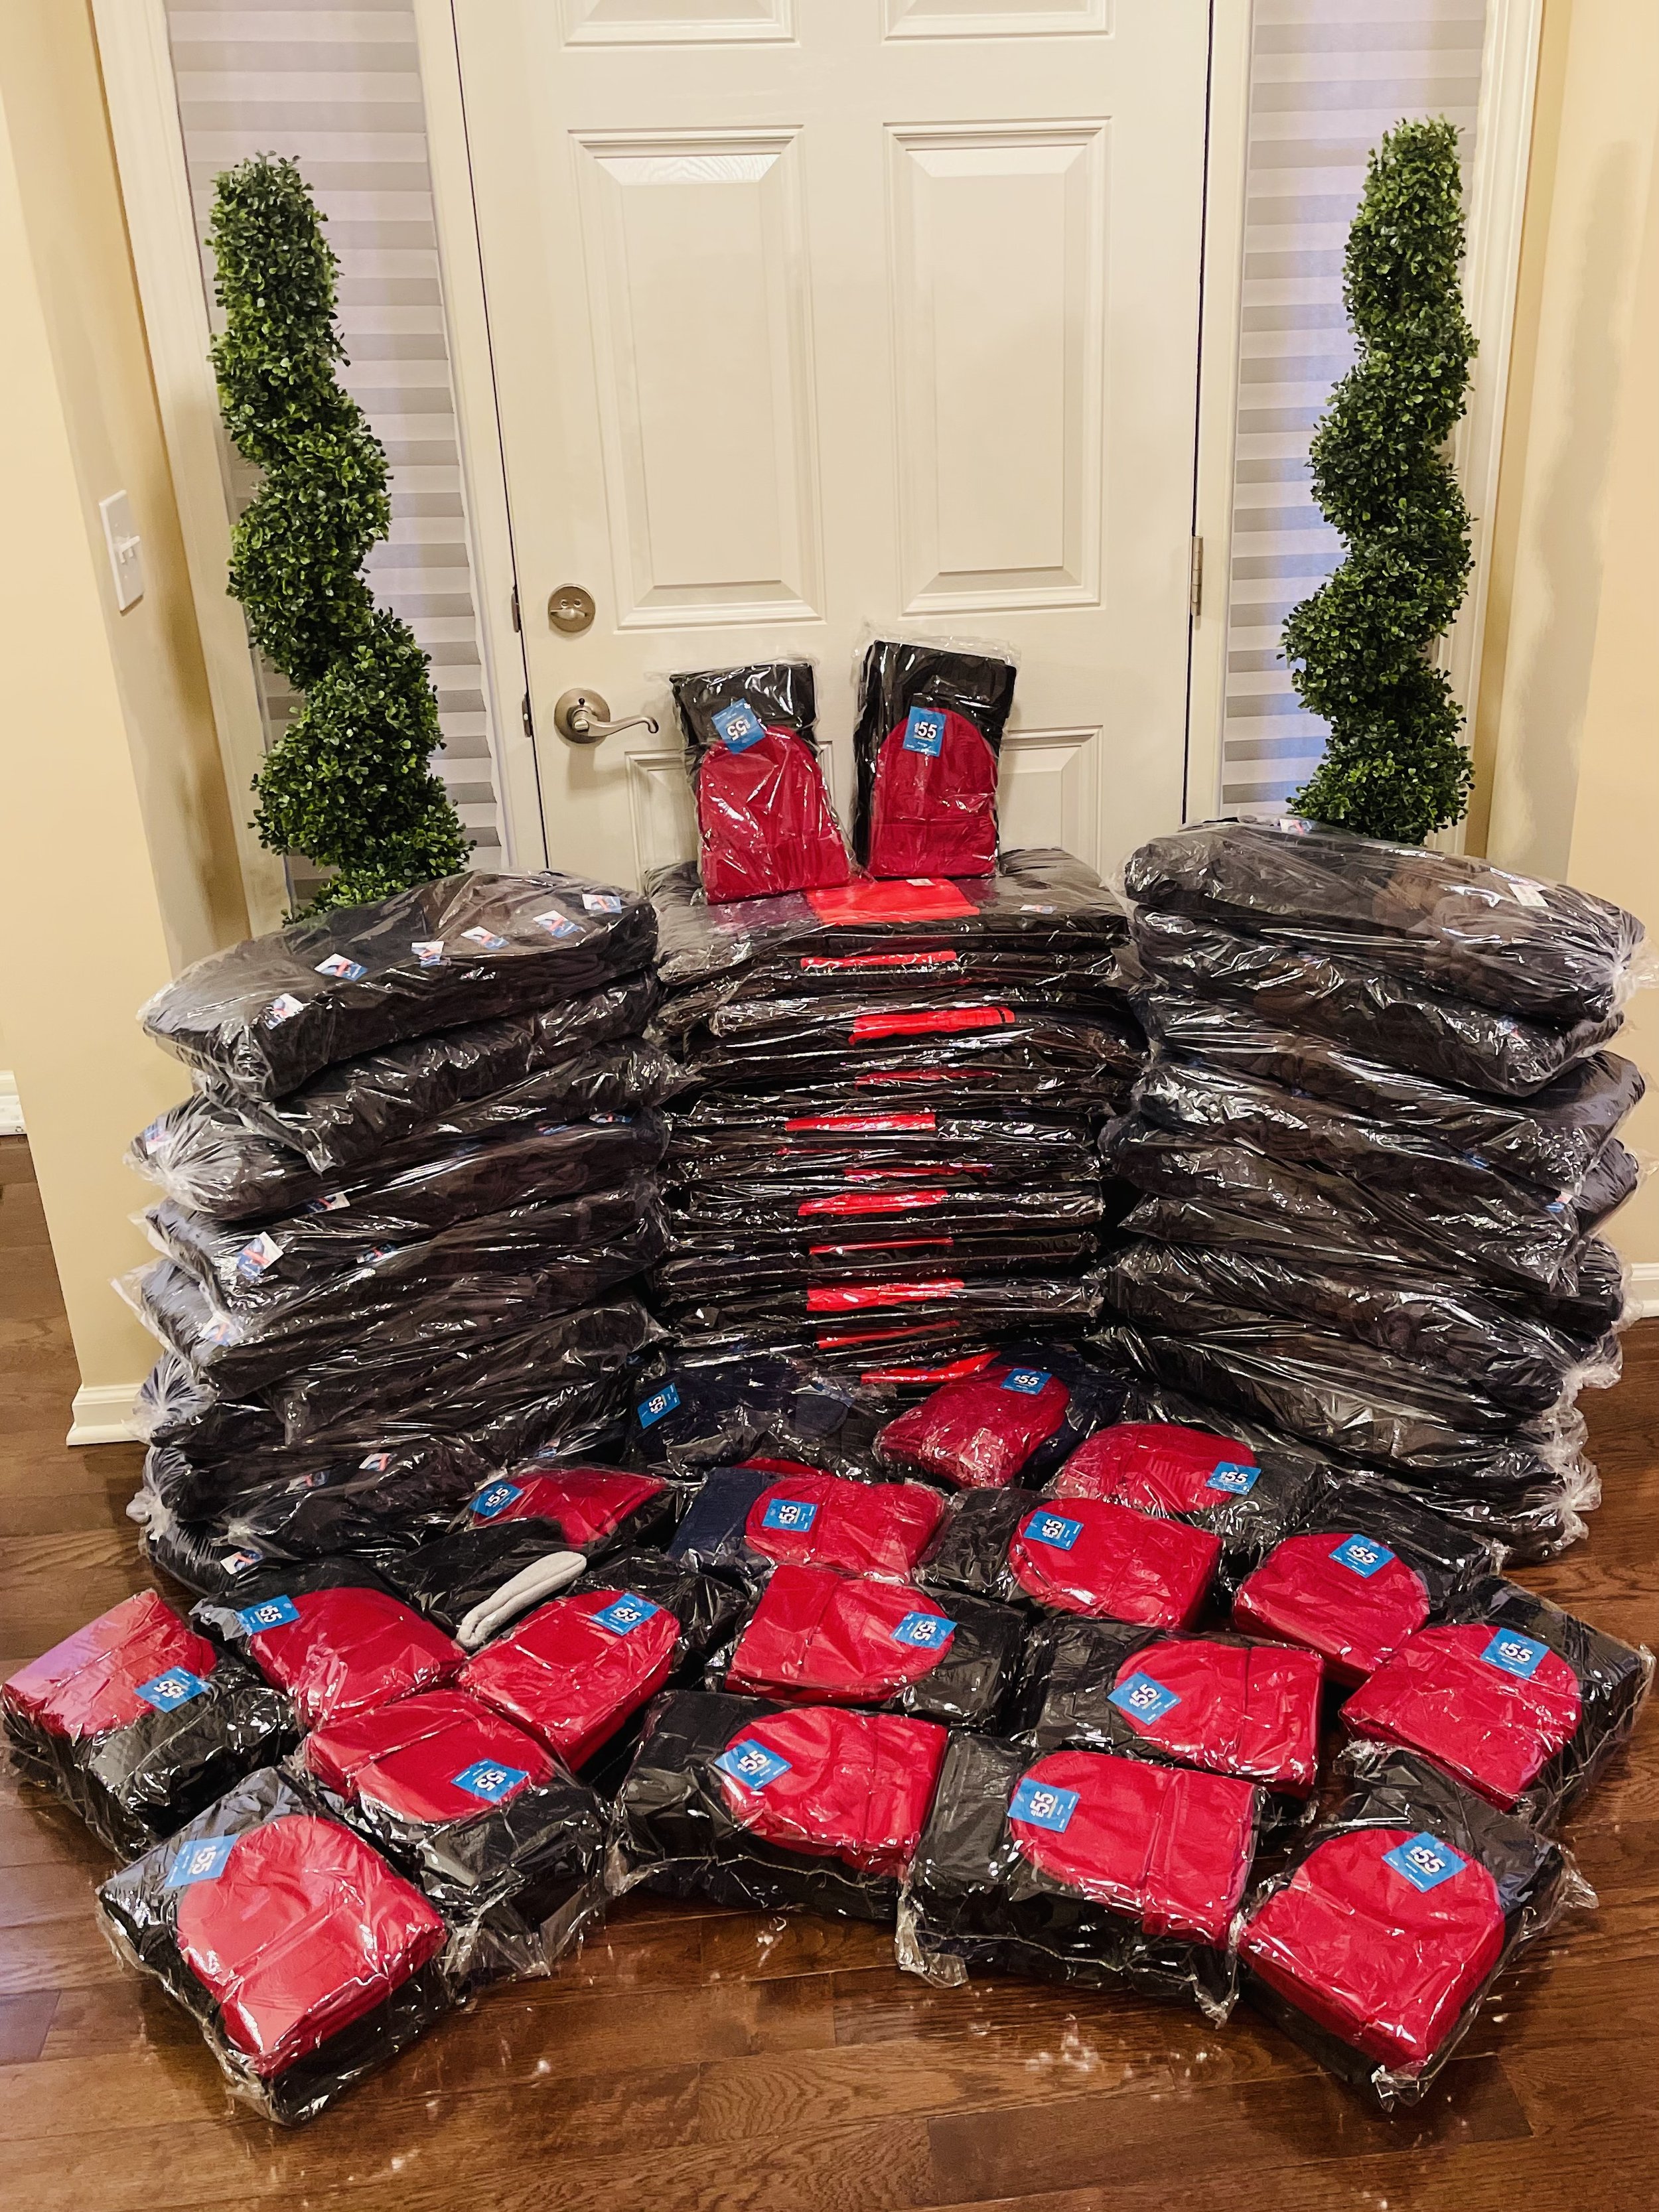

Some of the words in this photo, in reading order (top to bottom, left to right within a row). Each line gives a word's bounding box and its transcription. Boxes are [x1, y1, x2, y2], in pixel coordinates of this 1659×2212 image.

[727, 721, 748, 741] 55
[918, 722, 938, 738] 55
[1019, 1375, 1040, 1386] 55
[648, 1396, 663, 1413] 55
[1225, 1472, 1248, 1484] 55
[488, 1487, 509, 1505] 55
[778, 1505, 798, 1522] 55
[1042, 1518, 1062, 1536] 55
[1352, 1547, 1378, 1563] 55
[260, 1607, 283, 1623] 55
[616, 1608, 642, 1622] 55
[914, 1624, 936, 1641] 55
[1505, 1643, 1533, 1662] 55
[154, 1680, 182, 1698] 55
[1131, 1684, 1157, 1704] 55
[740, 1750, 767, 1770] 55
[477, 1772, 505, 1791] 55
[1030, 1791, 1054, 1813] 55
[192, 1851, 216, 1875] 55
[1414, 1849, 1446, 1874] 55
